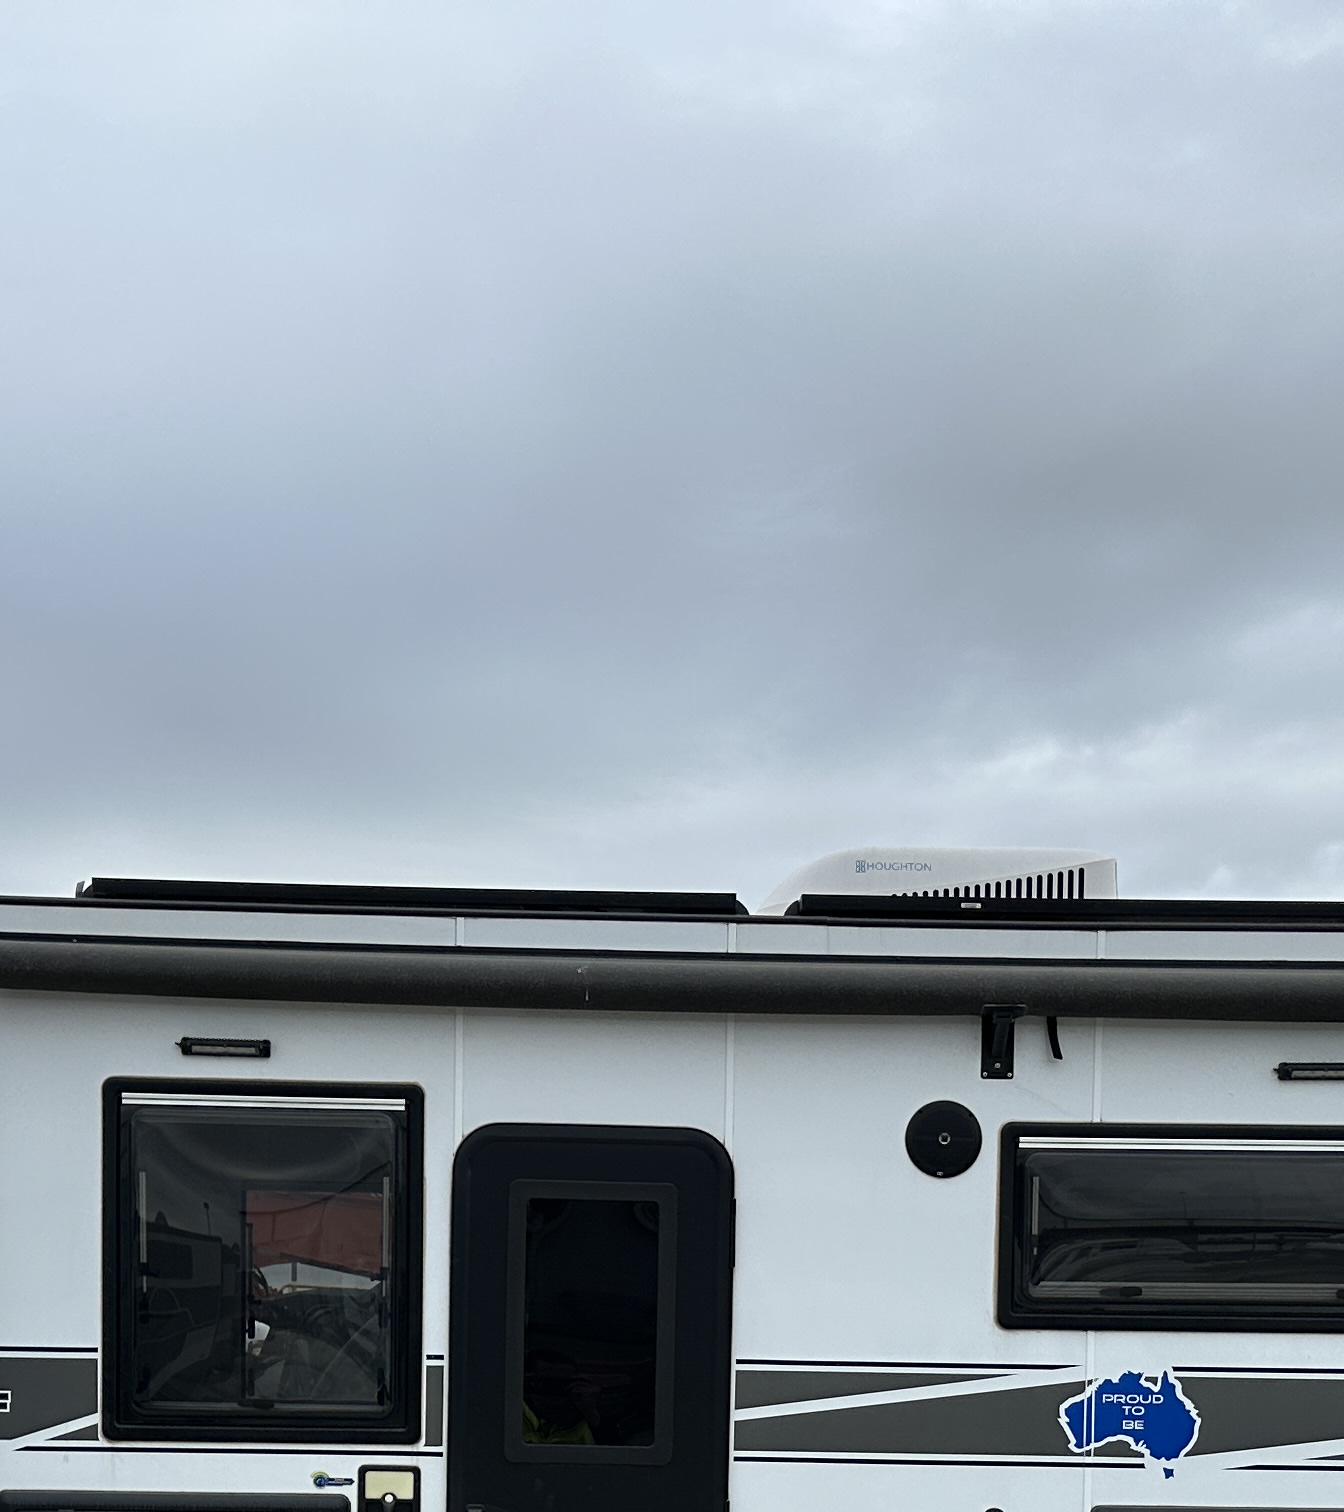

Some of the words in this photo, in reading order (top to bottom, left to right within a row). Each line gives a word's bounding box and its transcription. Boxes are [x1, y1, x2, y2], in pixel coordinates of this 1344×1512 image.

[866, 861, 932, 872] HOUGHTON
[1102, 1393, 1164, 1404] PROUD
[1121, 1405, 1145, 1416] TO
[1122, 1419, 1145, 1430] BE
